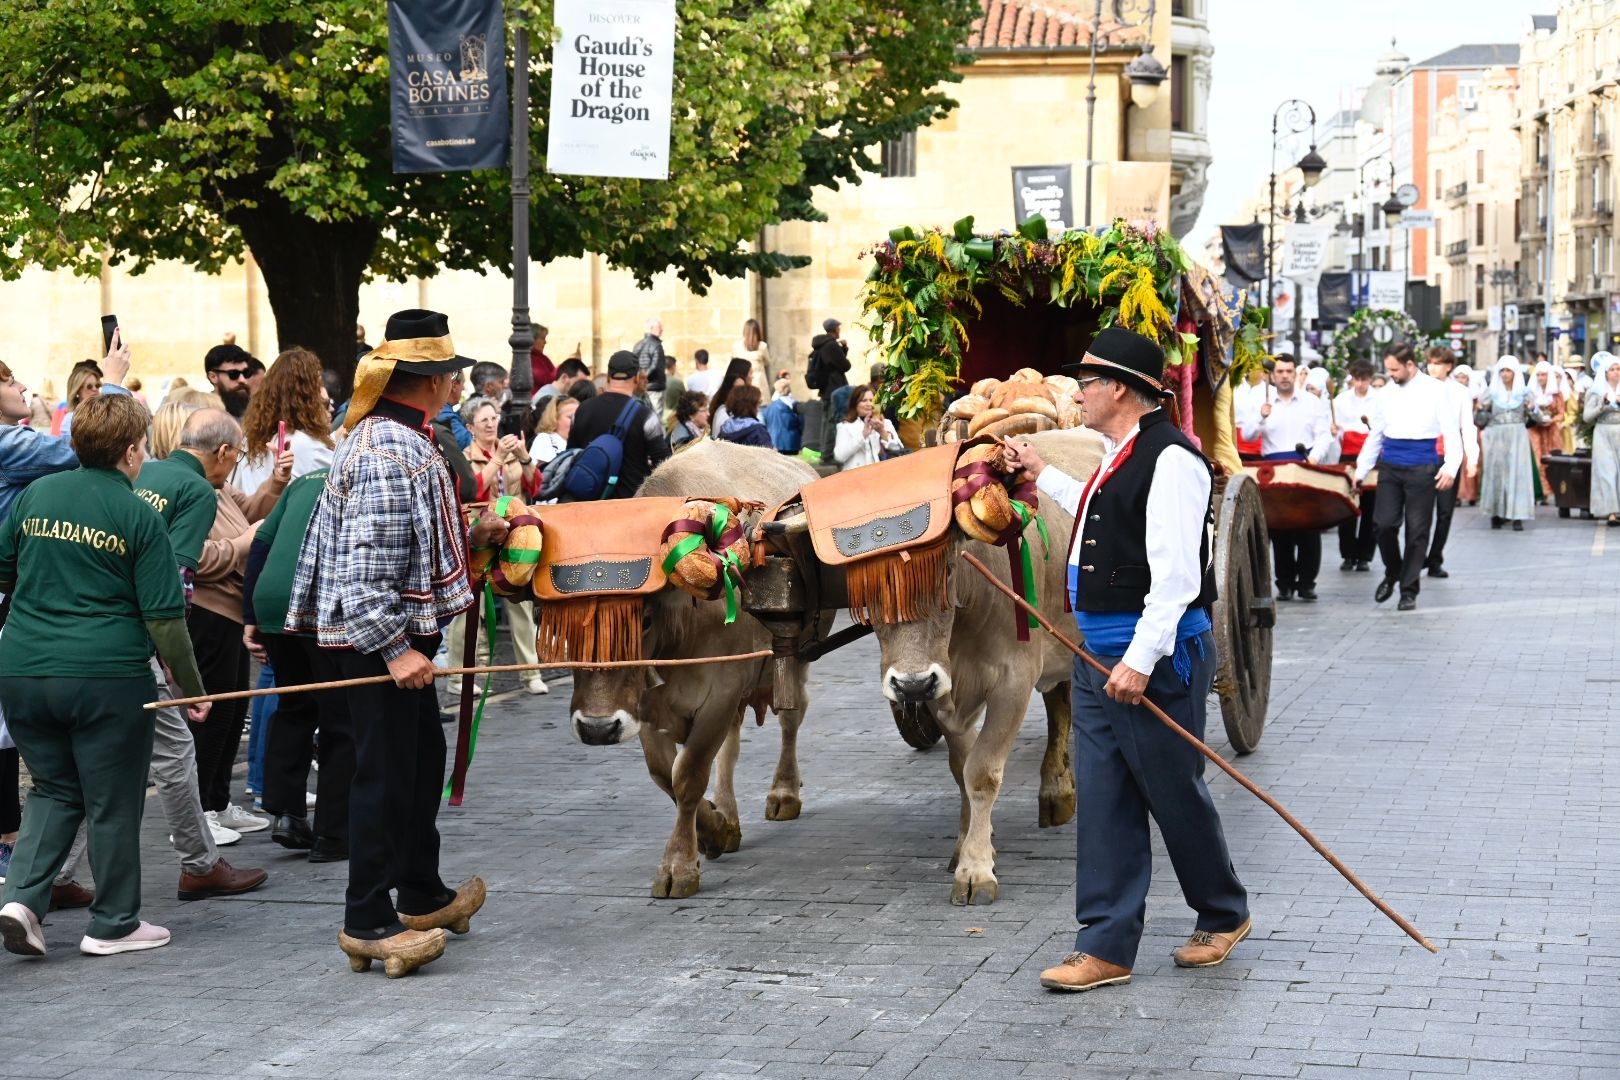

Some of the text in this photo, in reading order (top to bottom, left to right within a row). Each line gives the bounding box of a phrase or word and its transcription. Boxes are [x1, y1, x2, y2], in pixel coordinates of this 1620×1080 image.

[588, 13, 641, 24] DISCOVER
[407, 53, 452, 63] MUSEO
[579, 56, 646, 78] House
[408, 70, 457, 87] CASA
[580, 77, 643, 99] of the
[409, 84, 490, 104] BOTINES
[570, 99, 651, 125] Dragon
[425, 138, 476, 148] casabotines.es
[22, 518, 127, 557] VILLADANGOS
